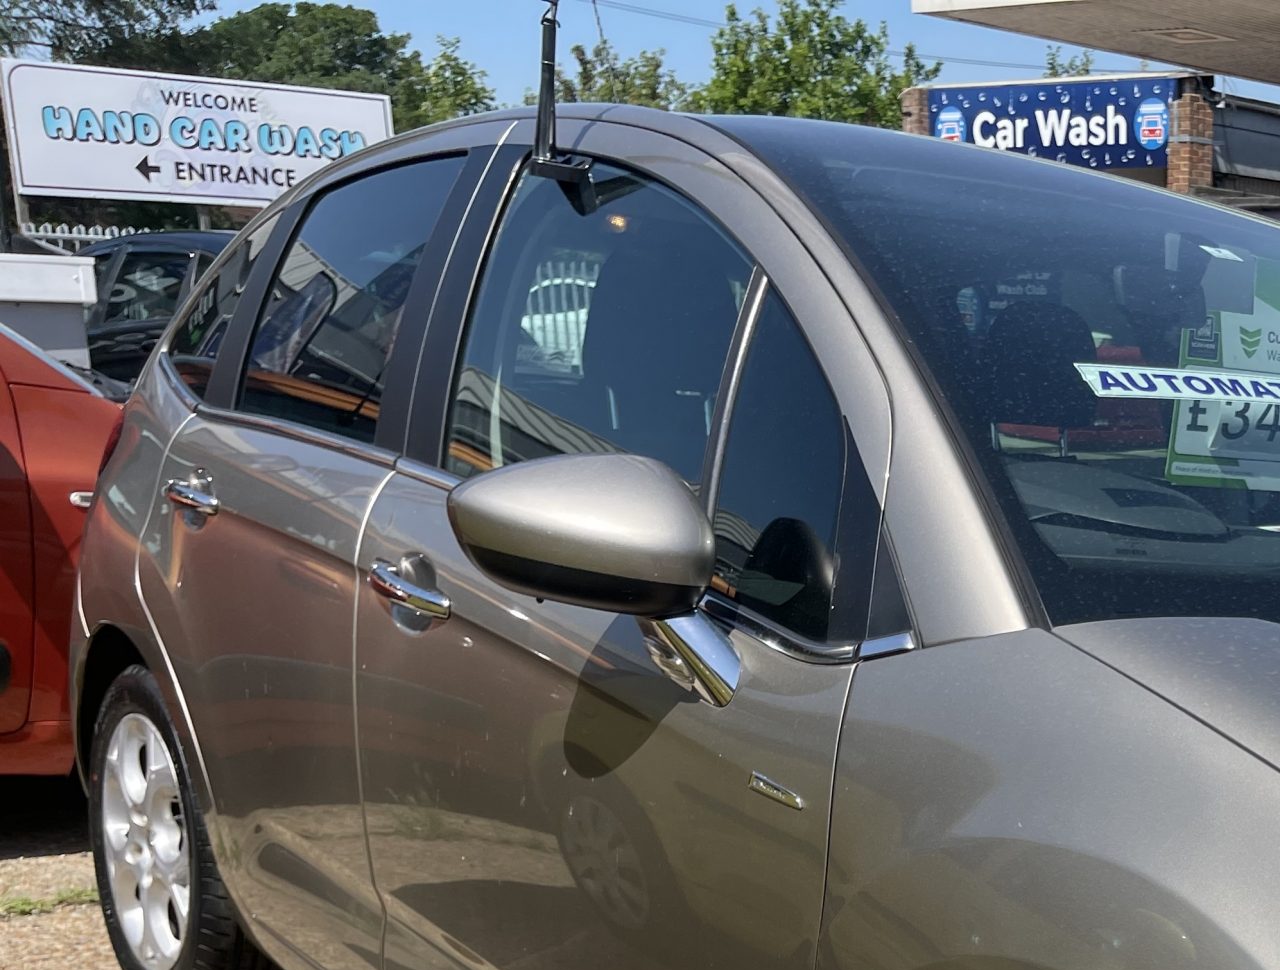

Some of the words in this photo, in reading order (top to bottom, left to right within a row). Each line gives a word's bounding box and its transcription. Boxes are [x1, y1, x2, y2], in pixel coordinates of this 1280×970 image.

[160, 89, 258, 113] WELCOME
[41, 105, 162, 147] HAND
[169, 115, 252, 153] CAR
[257, 122, 365, 160] WASH
[972, 110, 1029, 151] Car
[1035, 105, 1127, 147] Wash
[175, 161, 297, 188] ENTRANCE
